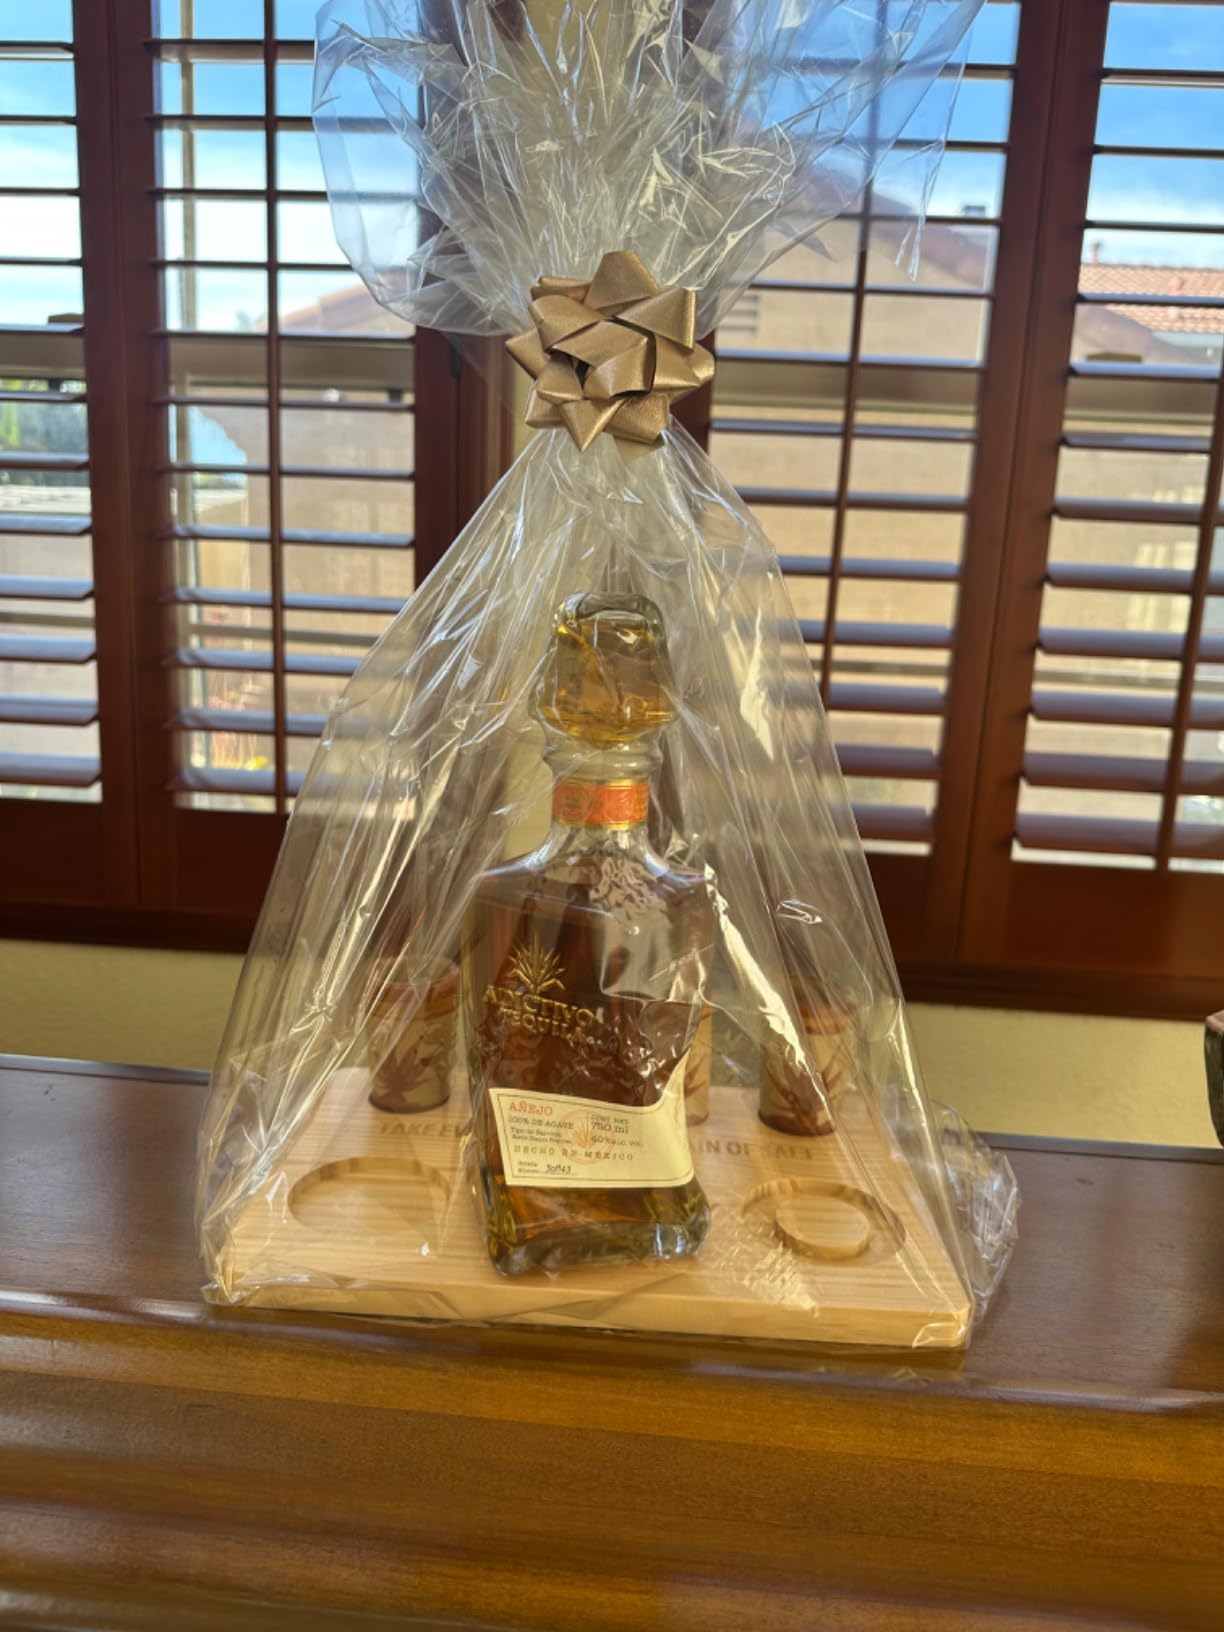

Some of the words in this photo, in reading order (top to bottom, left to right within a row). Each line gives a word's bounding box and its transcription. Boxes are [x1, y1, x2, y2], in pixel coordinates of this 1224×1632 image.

[482, 985, 594, 1026] ADICTIVO
[508, 1101, 553, 1116] AÑEJO
[381, 1122, 435, 1136] TAKE
[544, 1120, 575, 1130] AGAVE
[591, 1121, 612, 1131] 750
[513, 1144, 555, 1156] HECHO
